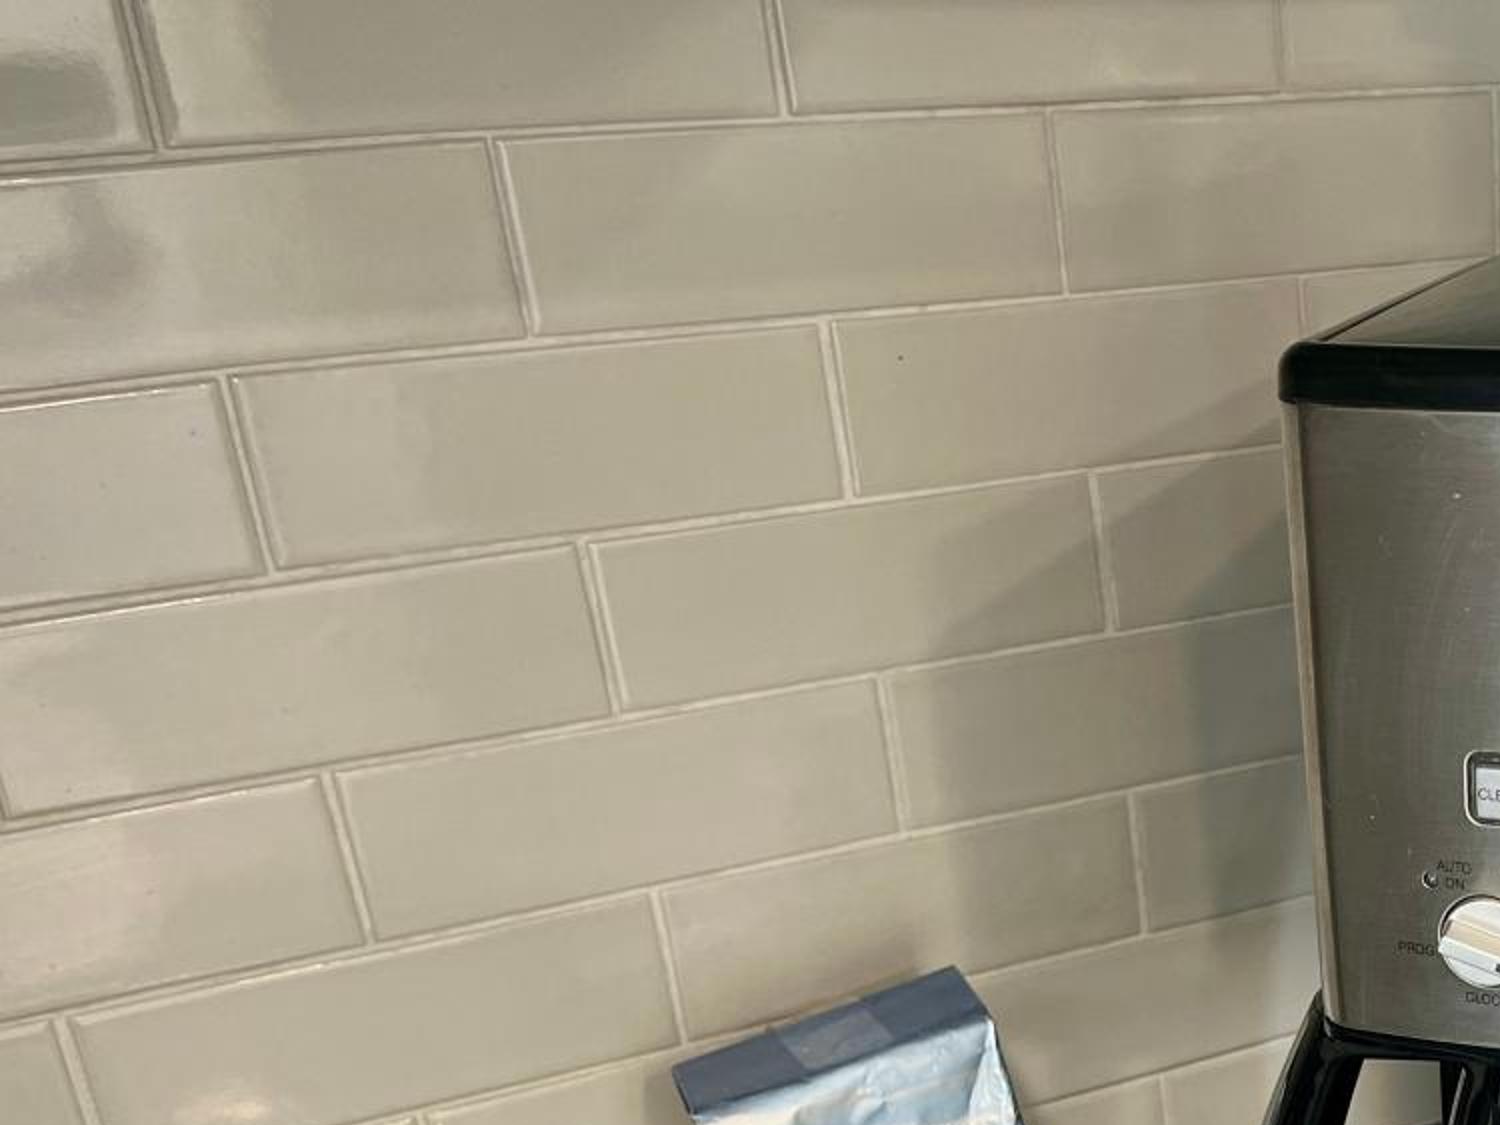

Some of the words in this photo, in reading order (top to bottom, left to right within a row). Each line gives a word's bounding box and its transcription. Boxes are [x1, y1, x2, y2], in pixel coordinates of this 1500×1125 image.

[1436, 860, 1471, 874] AUTO
[1446, 875, 1466, 890] ON
[1398, 940, 1436, 956] PROG
